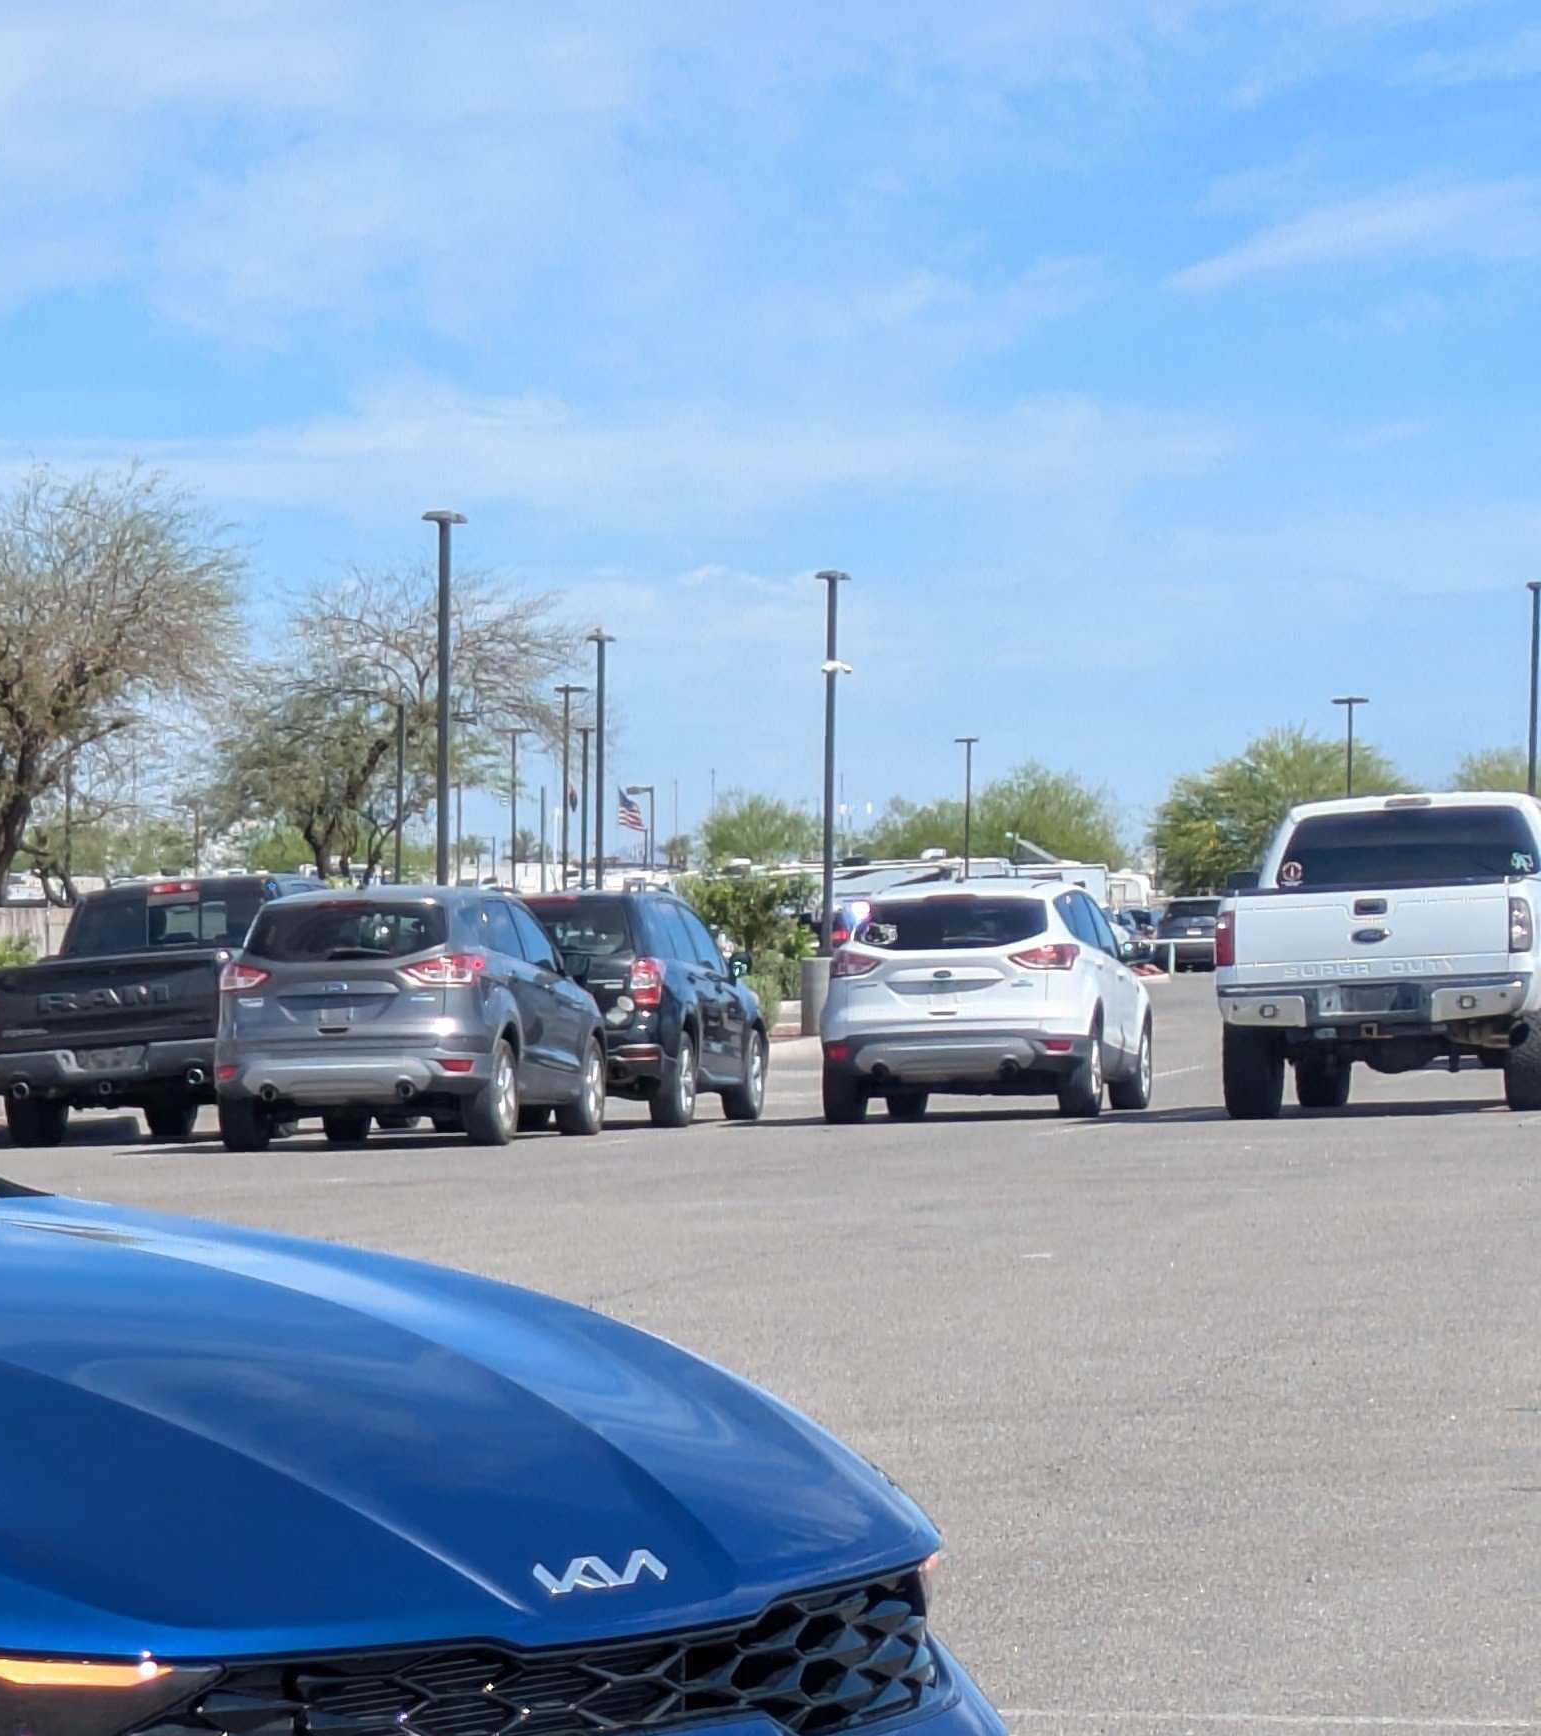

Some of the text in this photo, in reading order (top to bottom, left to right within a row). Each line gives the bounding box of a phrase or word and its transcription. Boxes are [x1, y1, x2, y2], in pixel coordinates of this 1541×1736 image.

[1284, 957, 1455, 979] SUPER DUTY
[37, 983, 172, 1015] RAM
[532, 1548, 668, 1596] KIA
